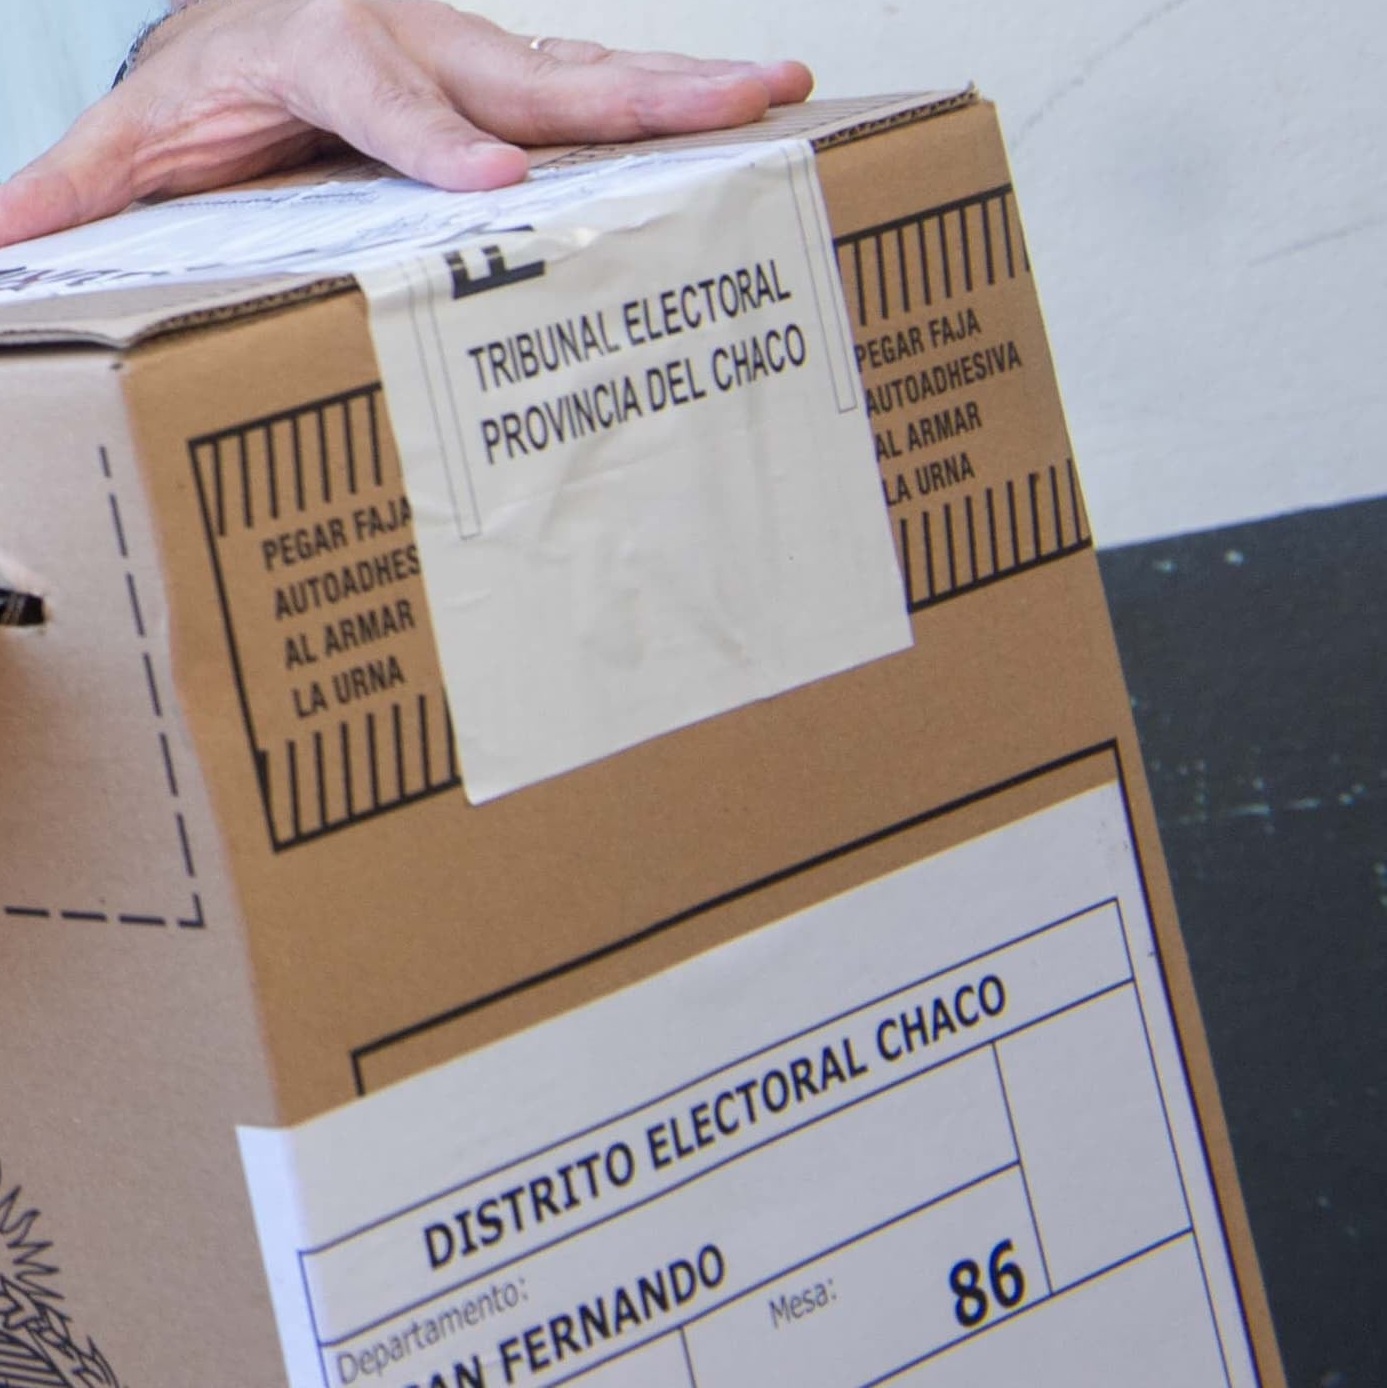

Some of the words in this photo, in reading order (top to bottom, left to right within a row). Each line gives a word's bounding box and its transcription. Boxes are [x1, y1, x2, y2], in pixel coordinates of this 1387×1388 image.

[468, 309, 622, 392] TRIBUNAL
[624, 259, 791, 347] ELECTORAL
[854, 327, 925, 373] PEGAR
[928, 308, 982, 348] FAJA
[481, 376, 643, 465] PROVINCIA
[647, 359, 706, 412] DEL
[711, 323, 807, 392] CHACO
[865, 340, 1023, 418] AUTOADHESIVA
[874, 429, 902, 463] AL
[907, 401, 983, 452] ARMAR
[882, 473, 912, 507] LA
[915, 452, 976, 496] URNA
[262, 517, 349, 572] PEGAR
[353, 495, 414, 542] FAJA
[284, 632, 318, 671] AL
[323, 598, 416, 658] ARMAR
[291, 681, 329, 719] LA
[332, 655, 406, 705] URNA
[424, 1141, 636, 1271] DISTRITO
[646, 1037, 867, 1171] ELECTORAL
[876, 974, 1007, 1063] CHACO
[499, 1243, 727, 1386] FERNANDO
[768, 1278, 839, 1330] Mesa:
[948, 1238, 1027, 1329] 86
[336, 1278, 530, 1386] Departamento:
